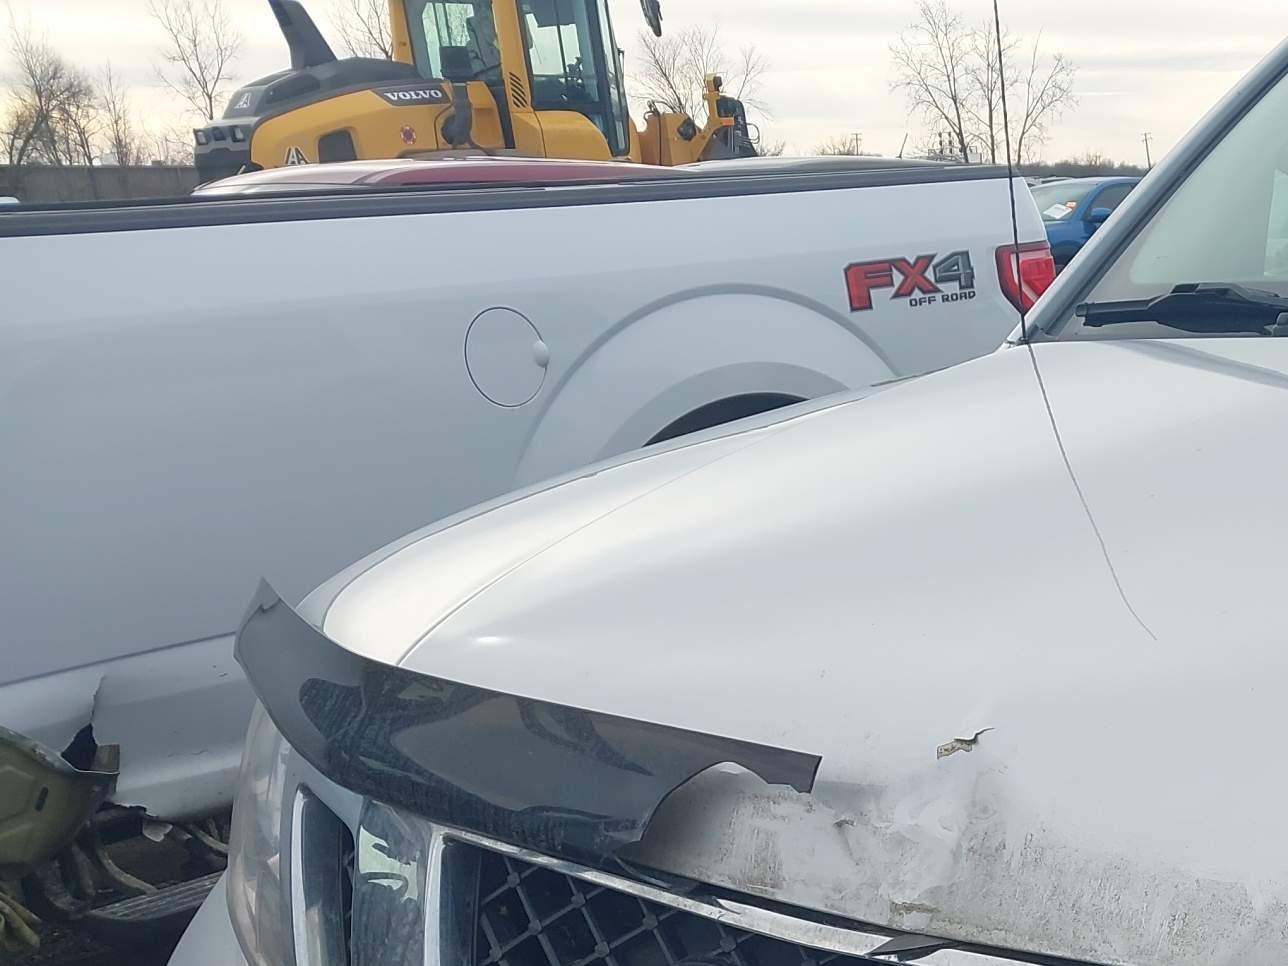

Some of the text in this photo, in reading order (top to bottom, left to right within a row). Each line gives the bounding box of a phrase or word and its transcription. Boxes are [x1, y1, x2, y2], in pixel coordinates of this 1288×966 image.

[384, 89, 442, 101] VOLVO
[843, 249, 975, 312] FX4
[909, 290, 976, 307] OFF ROAD
